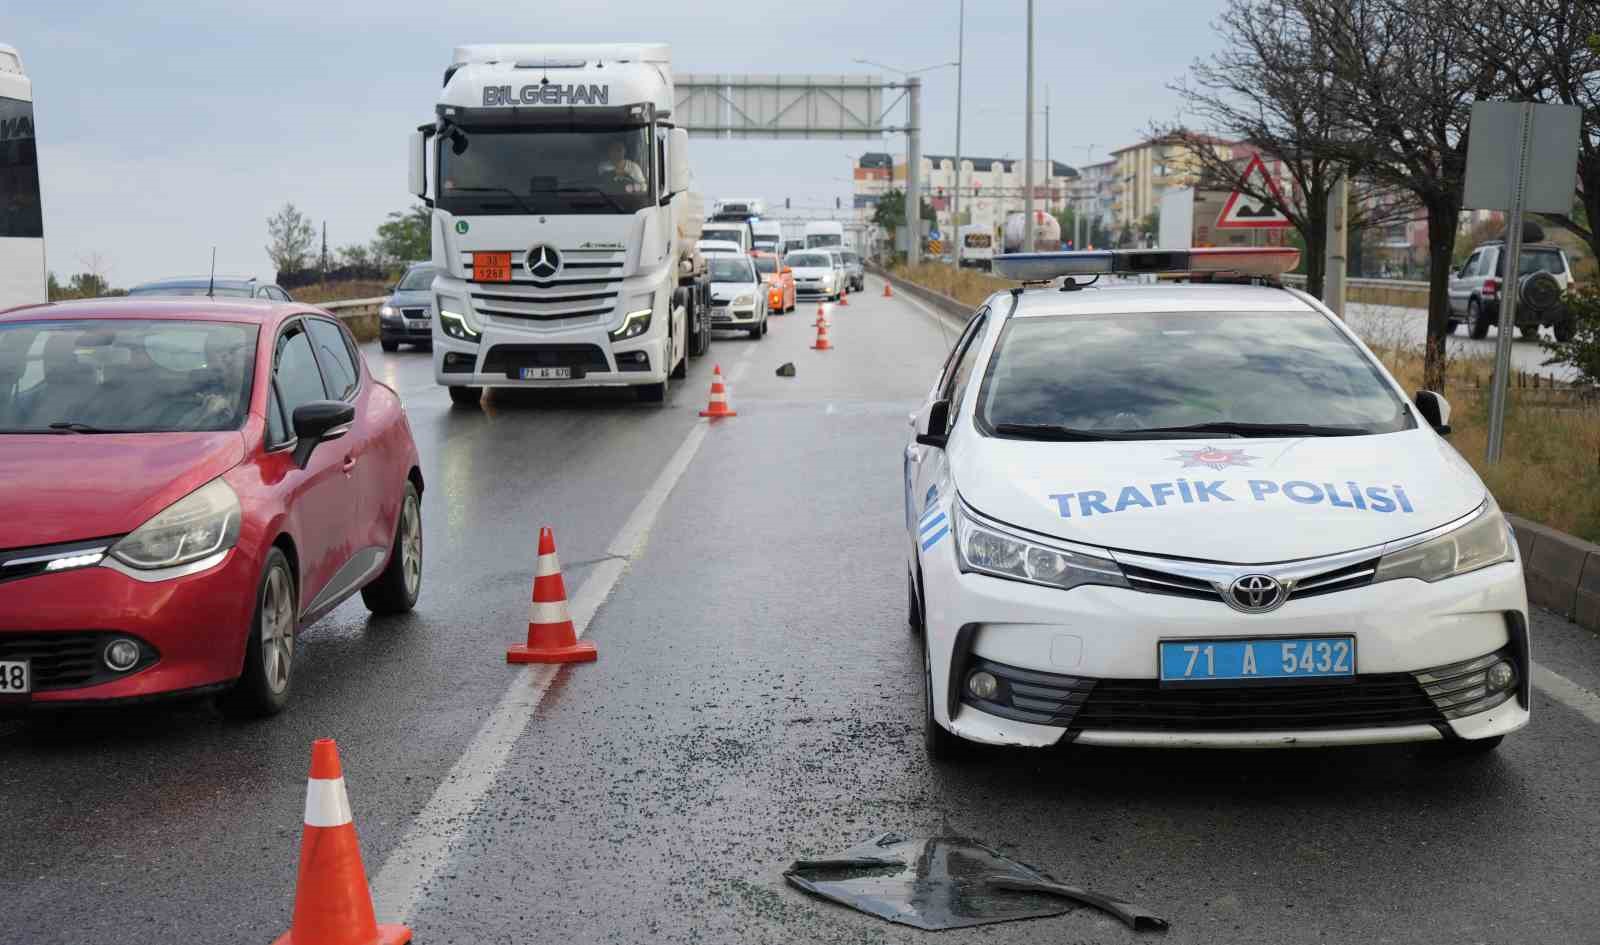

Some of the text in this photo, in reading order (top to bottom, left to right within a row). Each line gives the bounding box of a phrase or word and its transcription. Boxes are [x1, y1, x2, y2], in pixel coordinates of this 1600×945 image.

[1049, 478, 1415, 518] TRAFİK POLİSİ
[1183, 642, 1349, 677] 71 A 5432
